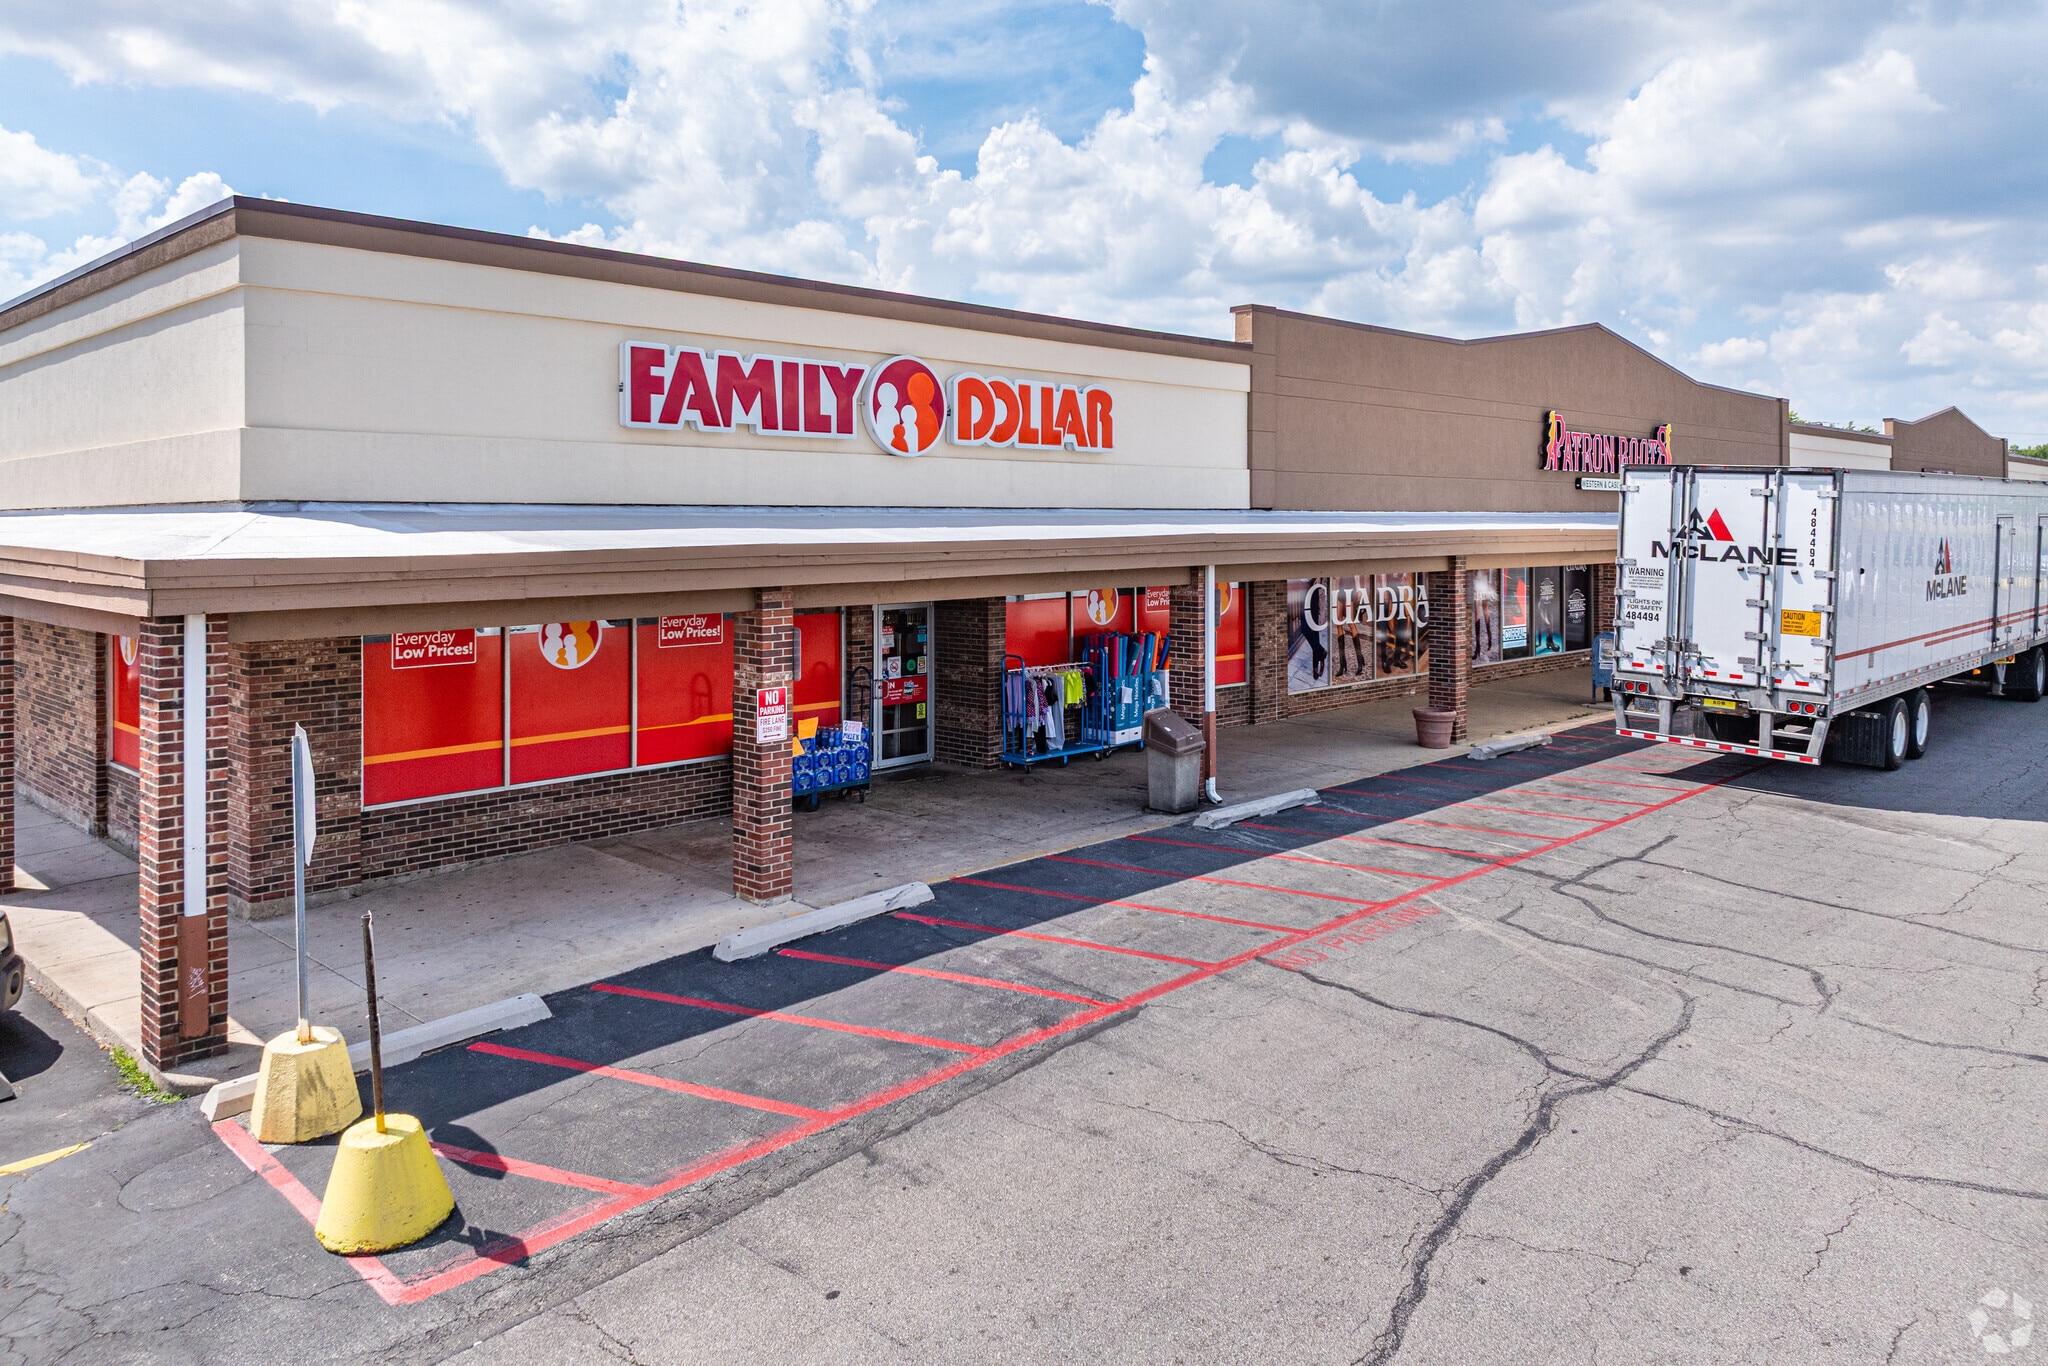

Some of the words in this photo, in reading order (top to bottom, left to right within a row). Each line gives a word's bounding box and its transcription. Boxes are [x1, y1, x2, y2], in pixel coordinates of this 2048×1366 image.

[630, 346, 865, 435] FAMILY
[957, 377, 1114, 449] DOLLAR
[1547, 412, 1615, 473] PATRON
[1618, 425, 1671, 465] BOOTS
[1809, 508, 1817, 567] 484494
[1628, 567, 1664, 577] WARNING
[1147, 598, 1159, 607] Low
[1304, 583, 1430, 632] CUADRA
[661, 614, 707, 630] Everyday
[1625, 610, 1659, 622] 484494
[1783, 611, 1805, 621] CAUTION
[395, 630, 456, 648] Everyday
[661, 628, 684, 640] Low
[686, 625, 720, 638] Prices!
[395, 646, 425, 660] Low
[428, 641, 473, 658] Prices!
[765, 690, 779, 705] NO
[760, 704, 784, 716] PARKING
[760, 717, 771, 726] FIRE
[772, 716, 784, 725] LANE
